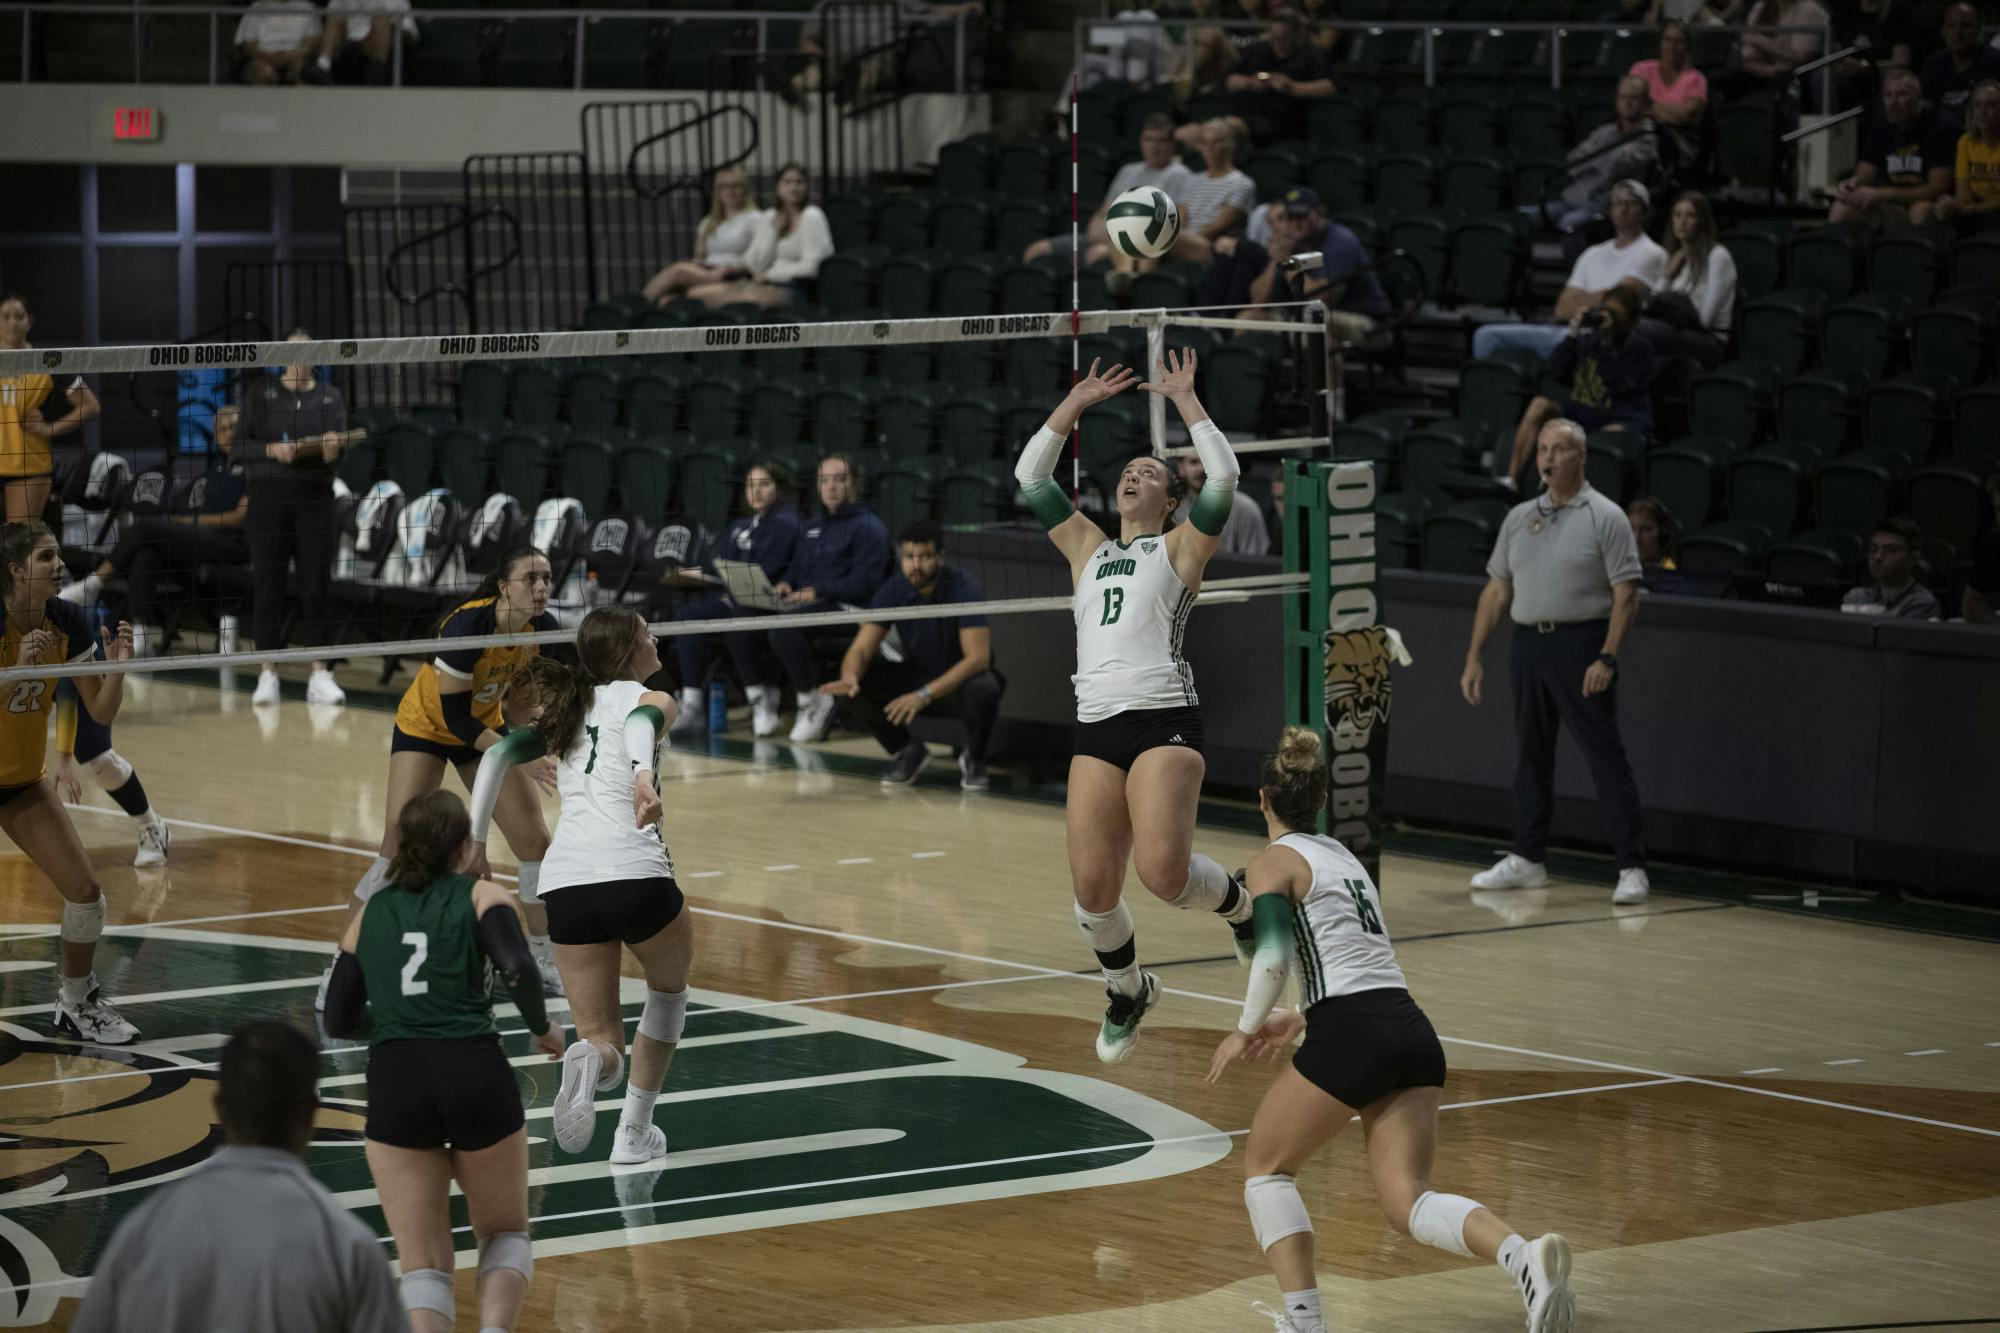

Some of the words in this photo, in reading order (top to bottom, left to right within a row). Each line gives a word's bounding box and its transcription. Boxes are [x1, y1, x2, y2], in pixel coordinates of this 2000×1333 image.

[706, 328, 740, 346] OHIO
[746, 326, 800, 343] BOBCATS
[961, 319, 994, 335] OHIO
[999, 316, 1050, 333] BOBCATS
[150, 345, 189, 365] OHIO
[195, 344, 257, 364] BOBCATS
[440, 337, 476, 355] OHIO
[481, 335, 540, 353] BOBCATS
[1327, 463, 1377, 632] OHIO
[1096, 559, 1136, 580] OHIO
[1100, 587, 1124, 626] 13
[401, 931, 429, 996] 2
